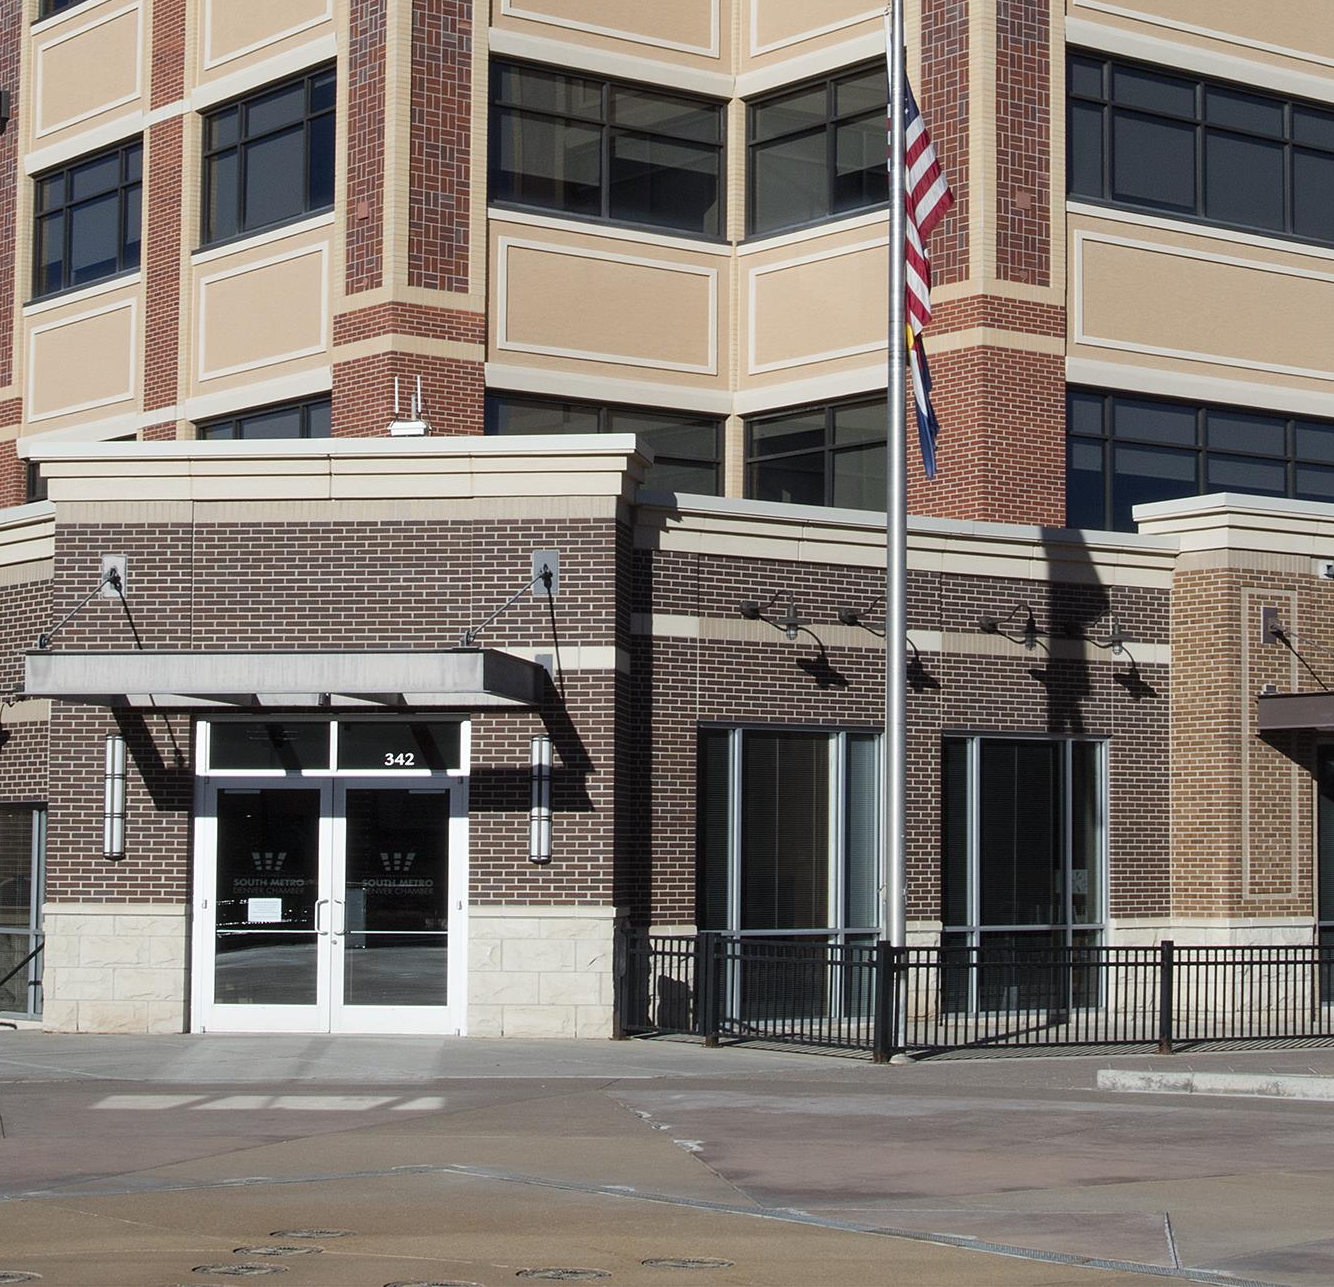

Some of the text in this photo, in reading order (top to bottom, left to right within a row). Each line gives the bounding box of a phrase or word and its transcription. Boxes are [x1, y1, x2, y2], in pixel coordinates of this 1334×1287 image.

[384, 752, 415, 766] 342
[233, 878, 305, 887] SOUTH METRO
[362, 878, 434, 887] SOUTH METRO
